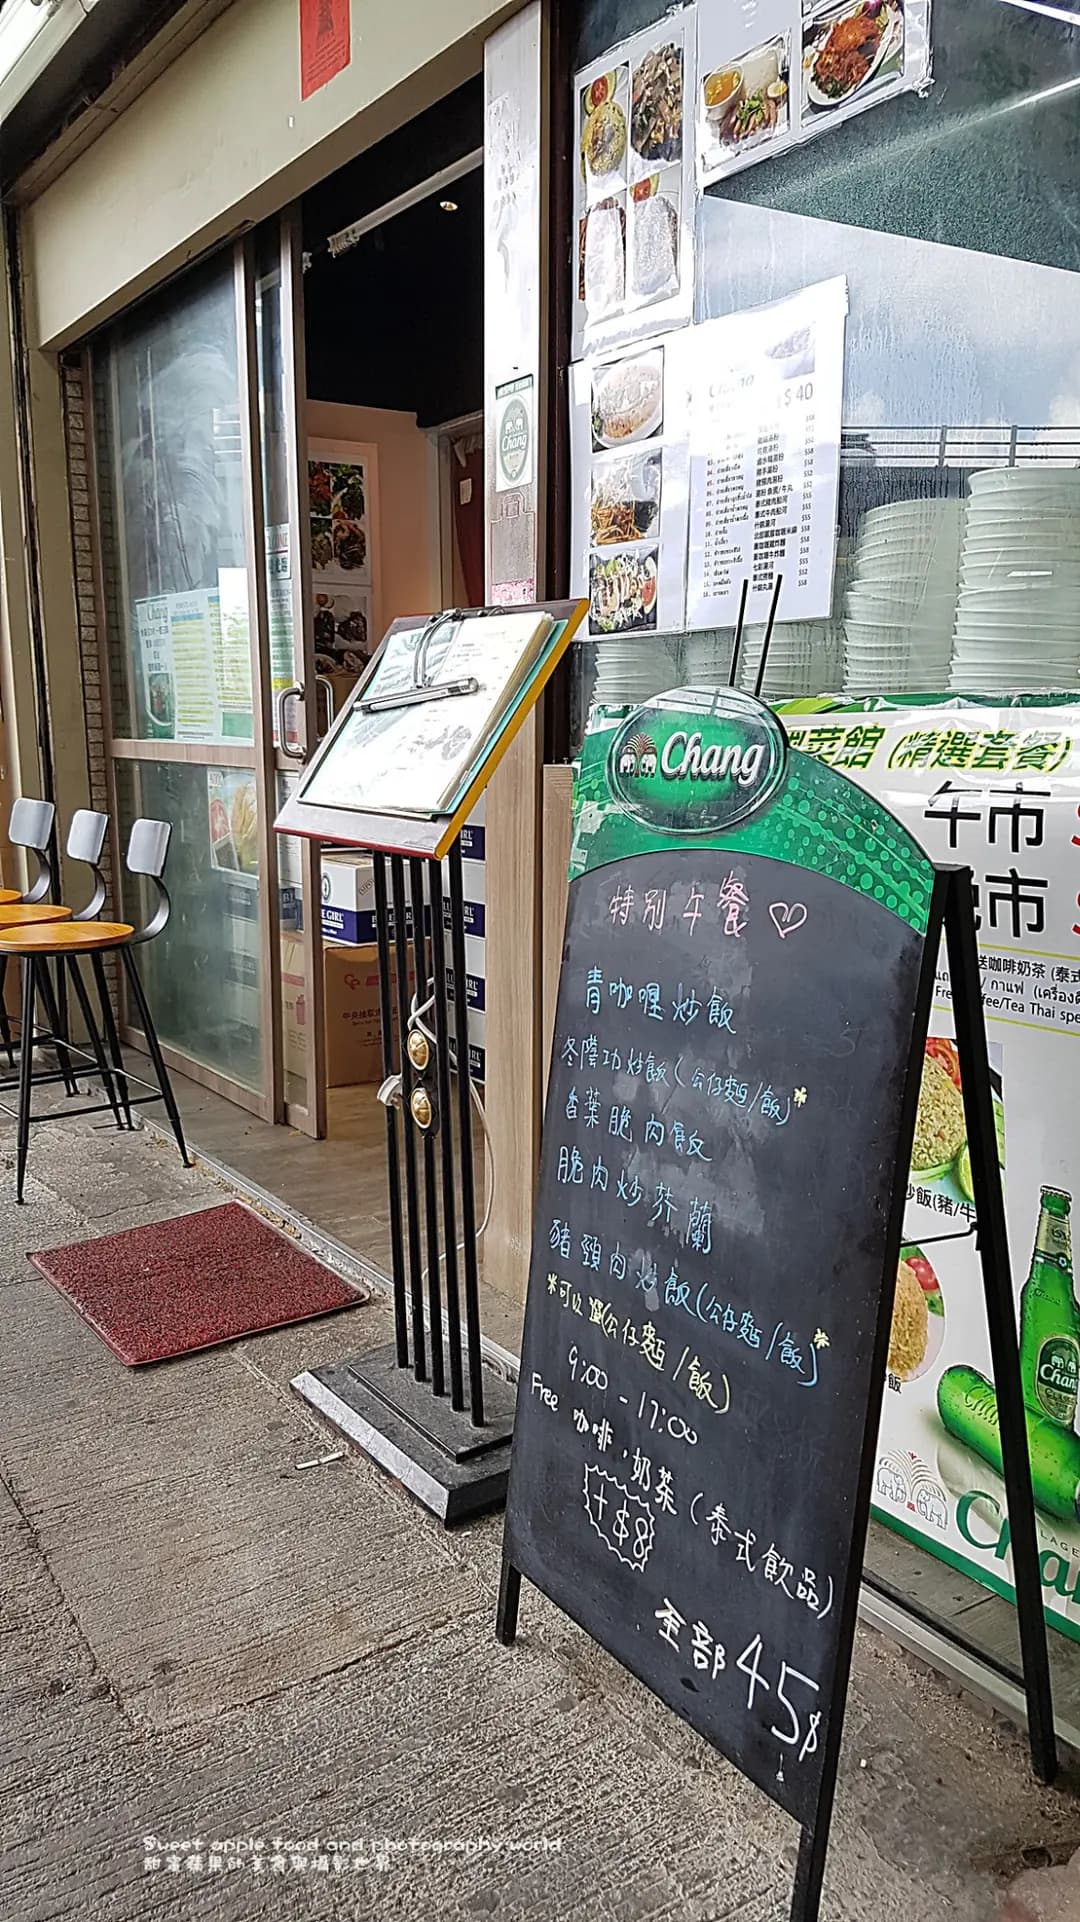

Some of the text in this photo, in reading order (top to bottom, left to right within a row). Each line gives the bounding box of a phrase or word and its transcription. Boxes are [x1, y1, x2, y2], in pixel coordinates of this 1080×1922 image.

[661, 731, 766, 785] Chang
[923, 781, 1051, 853] 午市
[326, 910, 343, 923] GIRL
[608, 870, 751, 938] 特別午餐
[973, 868, 1048, 938] 市
[1029, 1002, 1056, 1018] Thai
[531, 1372, 559, 1412] Free
[568, 1346, 609, 1390] 9:00
[638, 1391, 698, 1445] 17:00
